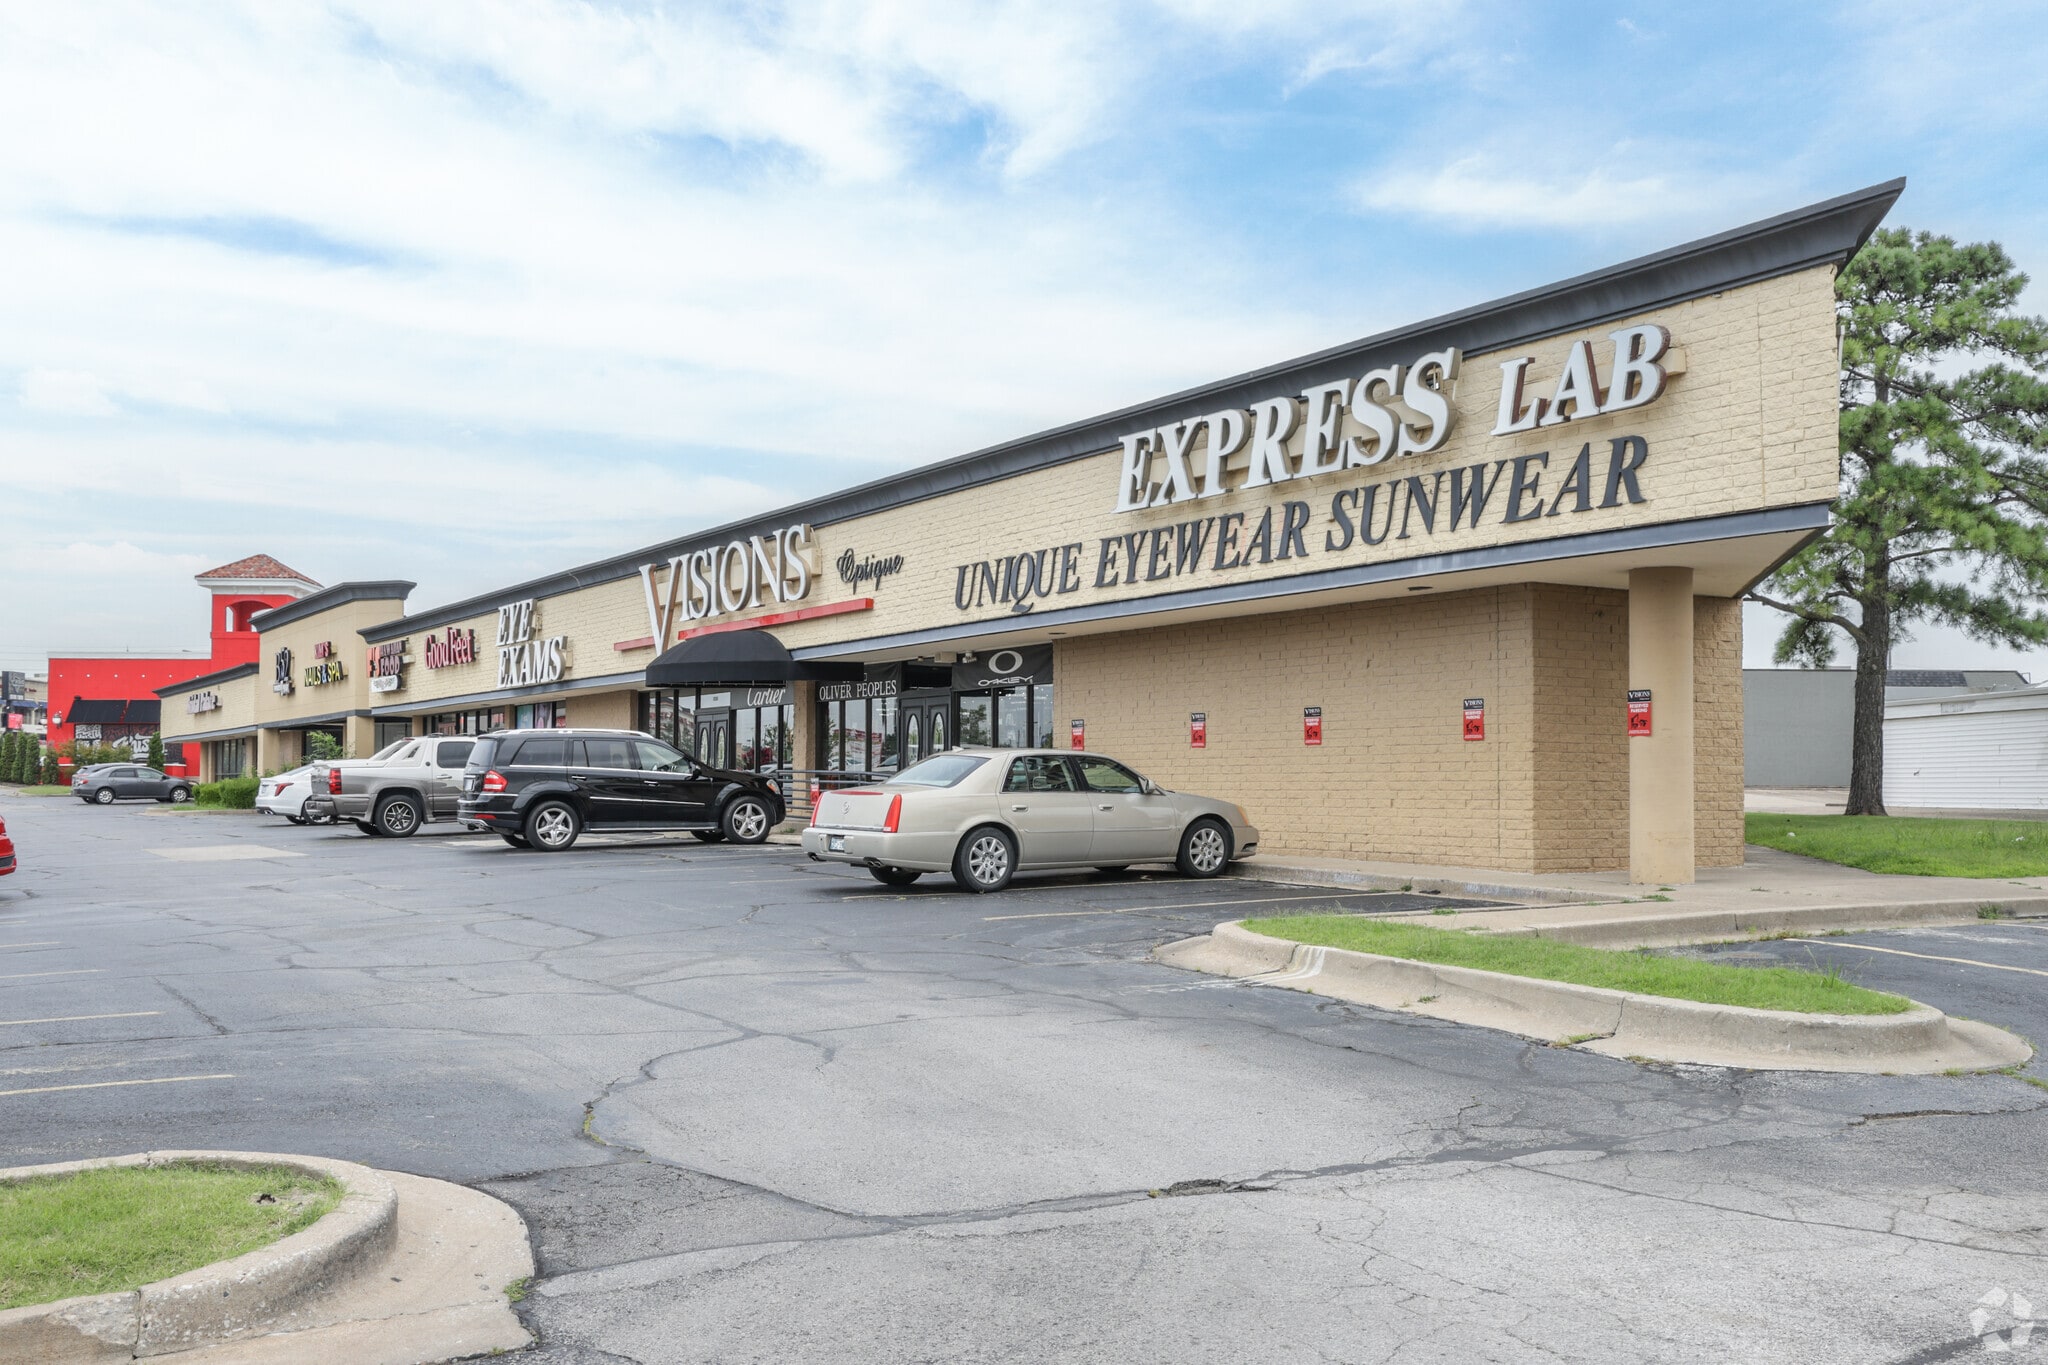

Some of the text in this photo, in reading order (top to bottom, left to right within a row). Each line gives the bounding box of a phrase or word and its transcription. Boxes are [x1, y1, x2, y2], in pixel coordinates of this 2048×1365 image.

[1111, 324, 1671, 514] EXPRESS LAB
[954, 434, 1648, 614] UNIQUE EYEWEAR SUNWEAR
[638, 523, 815, 657] VISIONS
[836, 547, 905, 595] Optique
[495, 598, 537, 647] EYE
[304, 665, 321, 687] NAILS
[320, 664, 328, 684] &
[327, 660, 343, 683] SPA
[380, 655, 403, 677] FOOD
[496, 635, 569, 689] EXAMS
[977, 675, 1034, 687] OAKLEY
[819, 679, 897, 701] OLIVER PEOPLES
[1628, 691, 1651, 699] VISIONS
